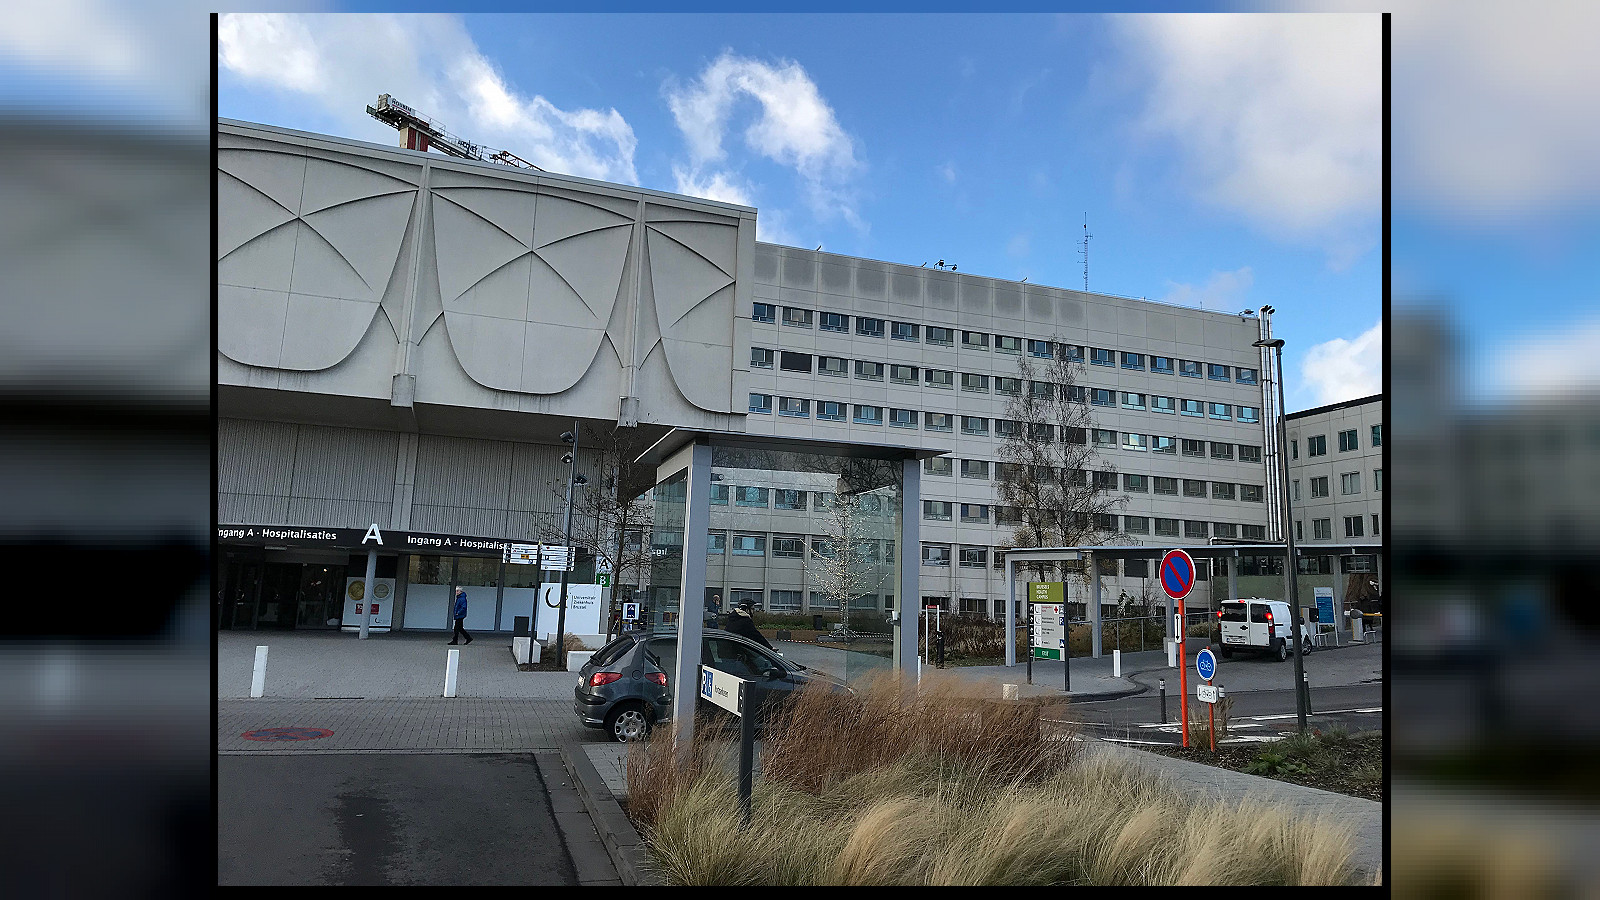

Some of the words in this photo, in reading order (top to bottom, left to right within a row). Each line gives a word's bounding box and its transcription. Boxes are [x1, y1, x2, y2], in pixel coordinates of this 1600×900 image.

[247, 528, 254, 537] A
[262, 528, 337, 540] Hospitalisaties
[361, 523, 384, 546] A
[407, 535, 442, 547] Ingang
[444, 537, 452, 546] A
[460, 538, 504, 550] Hospitalis
[599, 558, 609, 570] A
[599, 575, 607, 585] B
